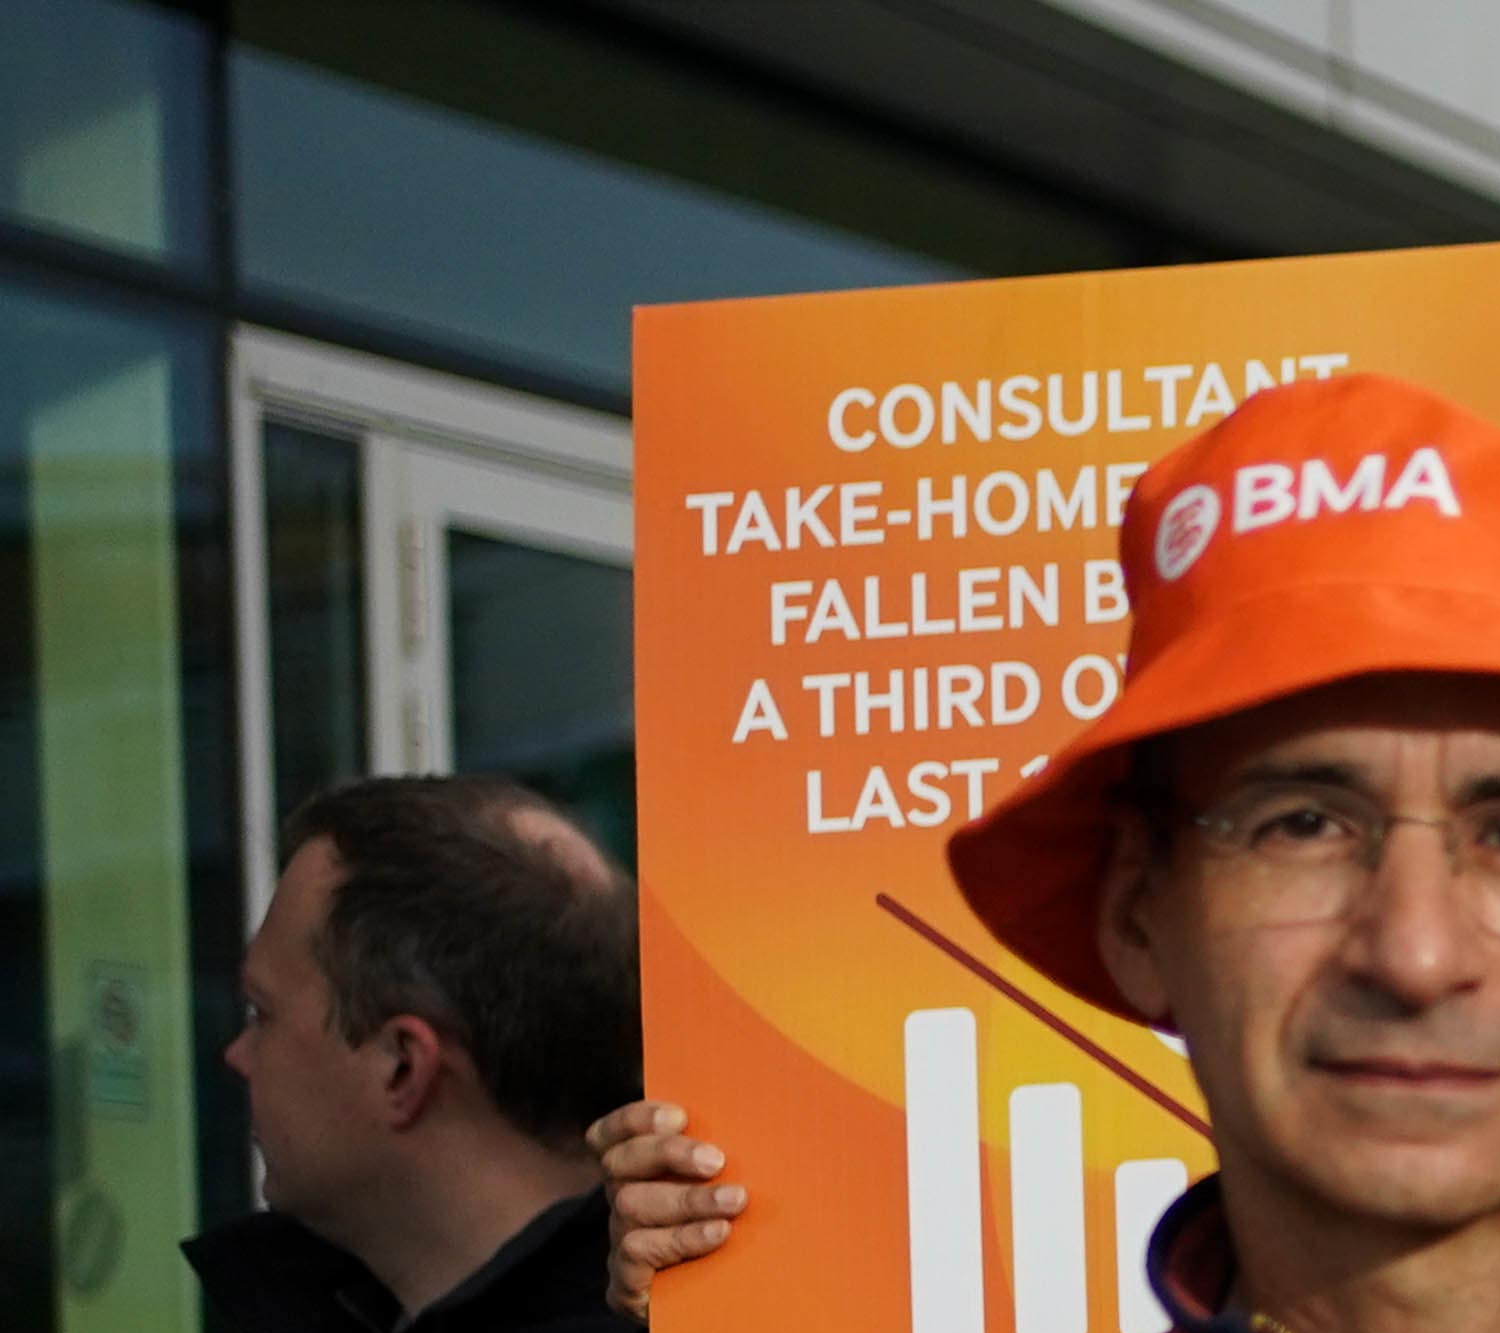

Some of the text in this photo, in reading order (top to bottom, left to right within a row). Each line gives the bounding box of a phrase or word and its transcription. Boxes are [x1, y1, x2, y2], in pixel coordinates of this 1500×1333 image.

[1232, 446, 1462, 534] BMA
[770, 562, 1060, 646] FALLEN
[731, 679, 789, 744] A
[801, 660, 1042, 738] THIRD
[805, 757, 1000, 835] LAST
